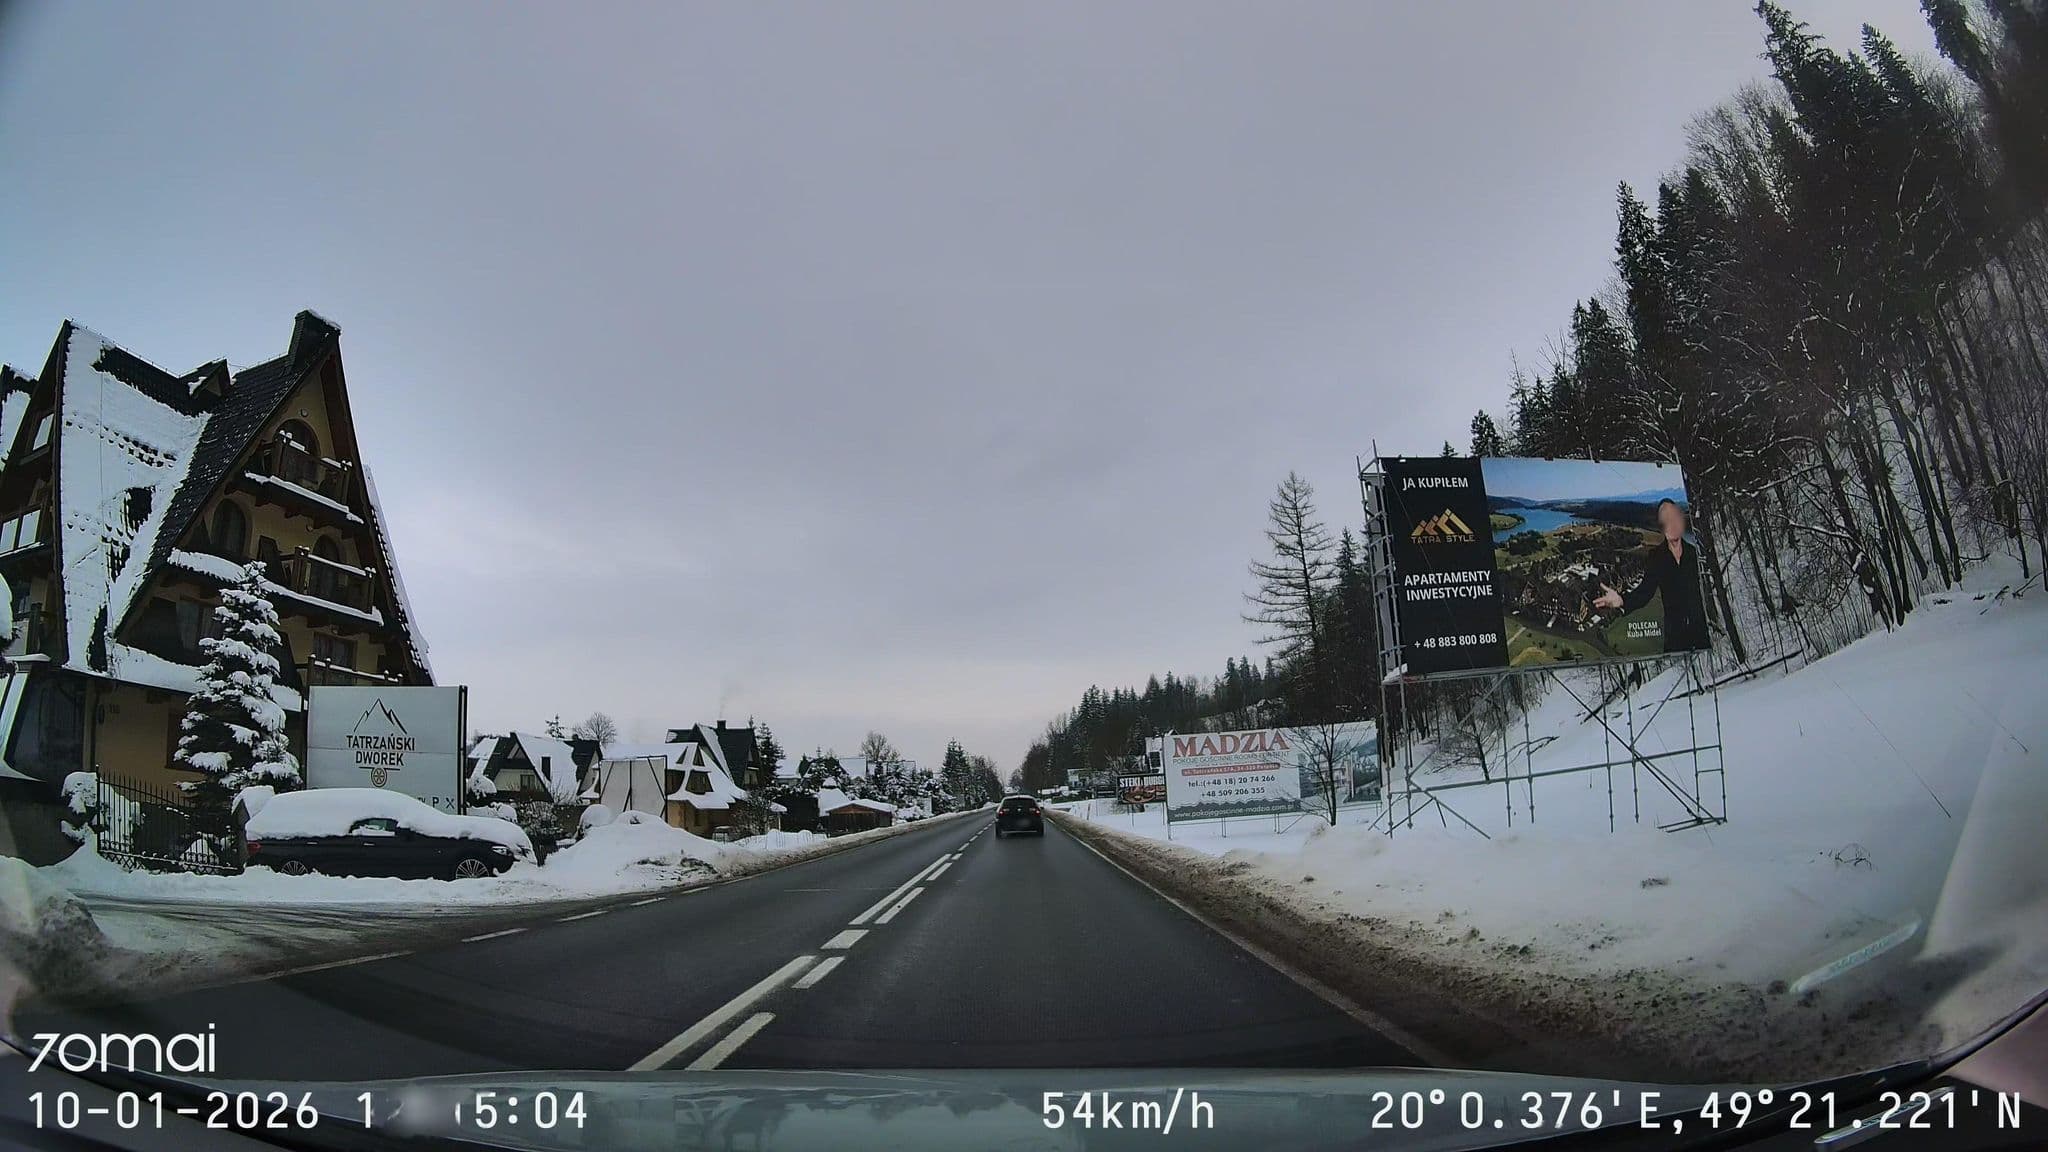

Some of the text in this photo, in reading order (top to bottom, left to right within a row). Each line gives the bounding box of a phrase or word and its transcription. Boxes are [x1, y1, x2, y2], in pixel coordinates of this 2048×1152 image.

[1402, 477, 1469, 491] JA KUPIŁEM
[1410, 534, 1476, 544] TATRA STYLE
[1404, 570, 1490, 586] APARTAMENTY
[1406, 584, 1493, 601] INWESTYCYJNE
[1628, 620, 1658, 630] POLECAM
[1423, 637, 1436, 649] 48
[1438, 636, 1456, 647] 883
[1459, 634, 1476, 645] 800
[1479, 633, 1497, 644] 808
[1627, 629, 1643, 638] Kuba
[346, 733, 415, 751] TATRZAŃSKI
[1173, 729, 1290, 758] MADZIA
[355, 750, 405, 766] DWOREK
[1225, 777, 1236, 786] 18)
[1238, 776, 1248, 784] 20
[1250, 775, 1259, 783] 74
[1262, 774, 1275, 782] 266
[1201, 786, 1265, 798] +48 509 206 355
